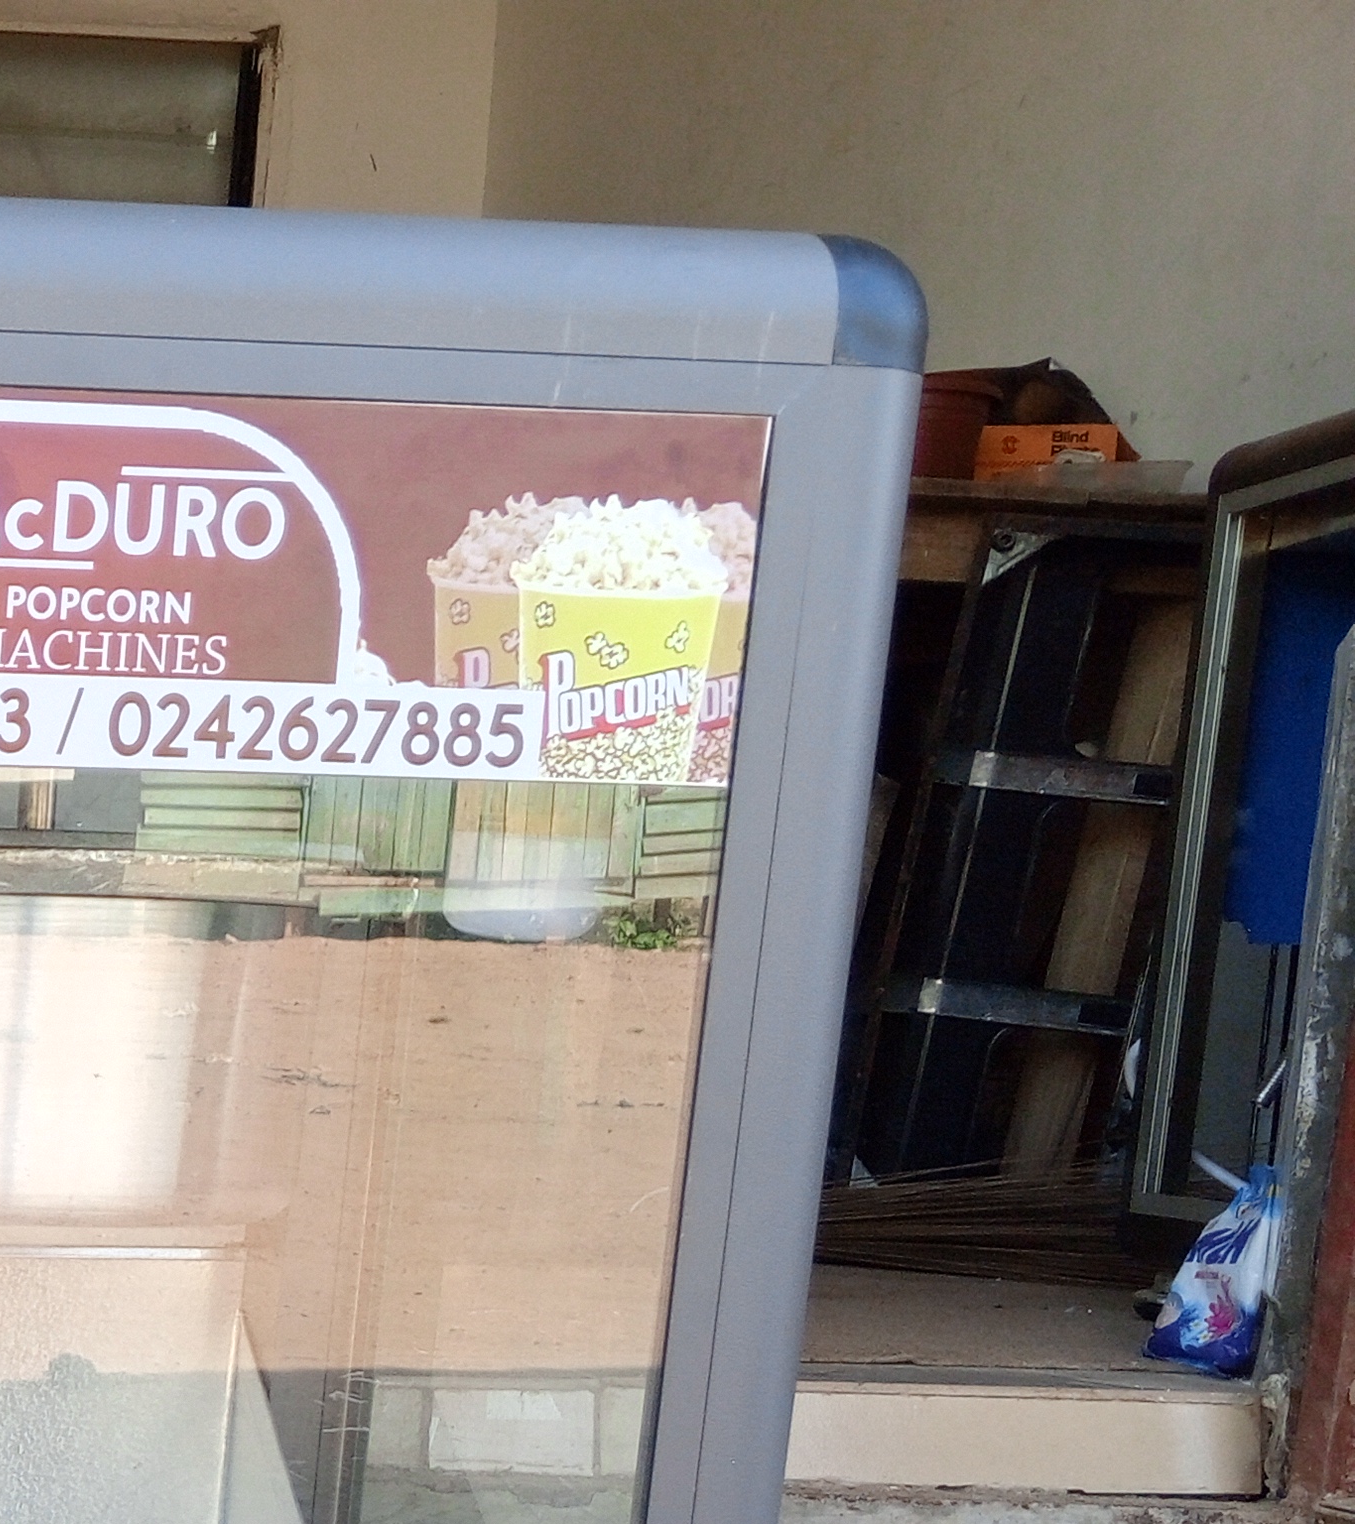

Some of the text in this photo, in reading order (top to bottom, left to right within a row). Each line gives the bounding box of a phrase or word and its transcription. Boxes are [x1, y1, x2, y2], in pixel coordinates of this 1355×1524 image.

[1051, 430, 1089, 443] Blind
[6, 585, 192, 625] POPCORN
[538, 650, 691, 747] POPCORN
[108, 691, 524, 768] 0242627885
